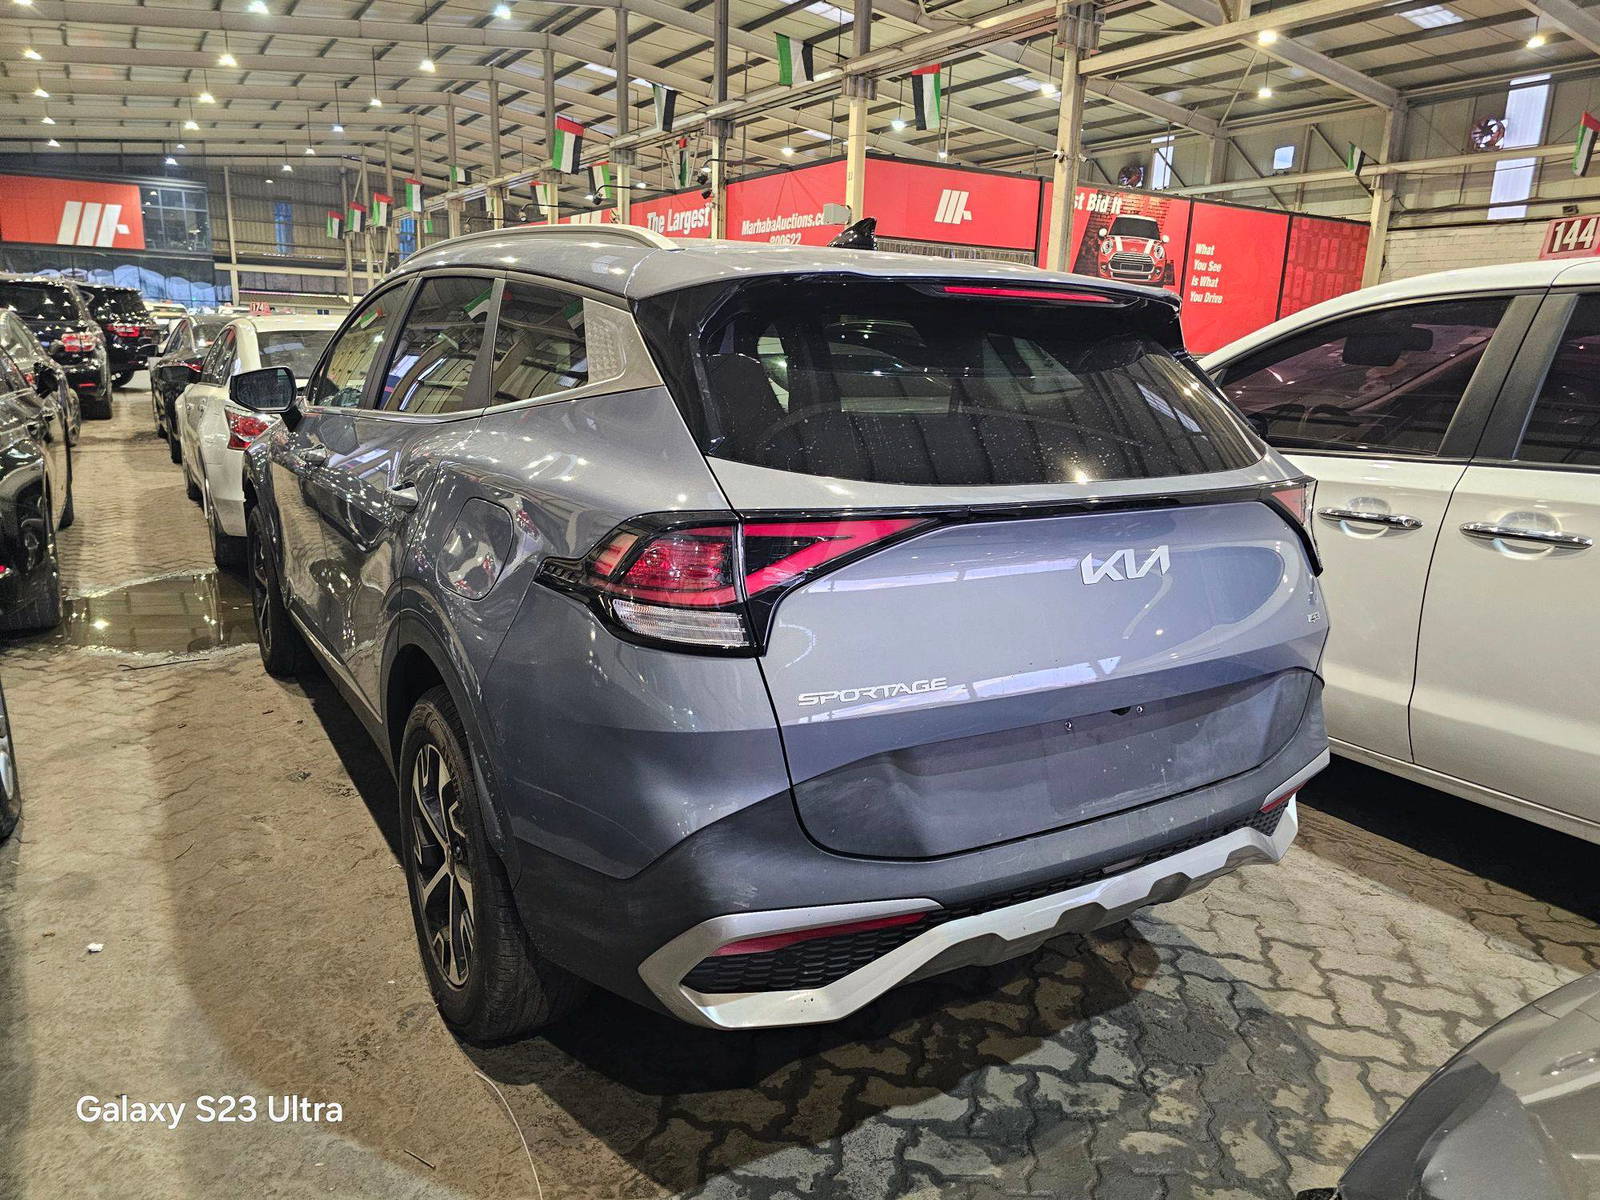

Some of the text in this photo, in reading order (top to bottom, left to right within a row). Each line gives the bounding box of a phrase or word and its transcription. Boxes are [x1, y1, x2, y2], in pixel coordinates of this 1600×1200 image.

[1086, 193, 1111, 213] Bid
[647, 202, 711, 235] The Largest
[1551, 217, 1598, 253] 144
[1195, 243, 1215, 256] What
[1193, 259, 1222, 272] You See
[1191, 275, 1219, 288] Is What
[1190, 291, 1223, 304] You Drive
[1080, 545, 1170, 585] KIA
[799, 677, 948, 706] SPORTAGE
